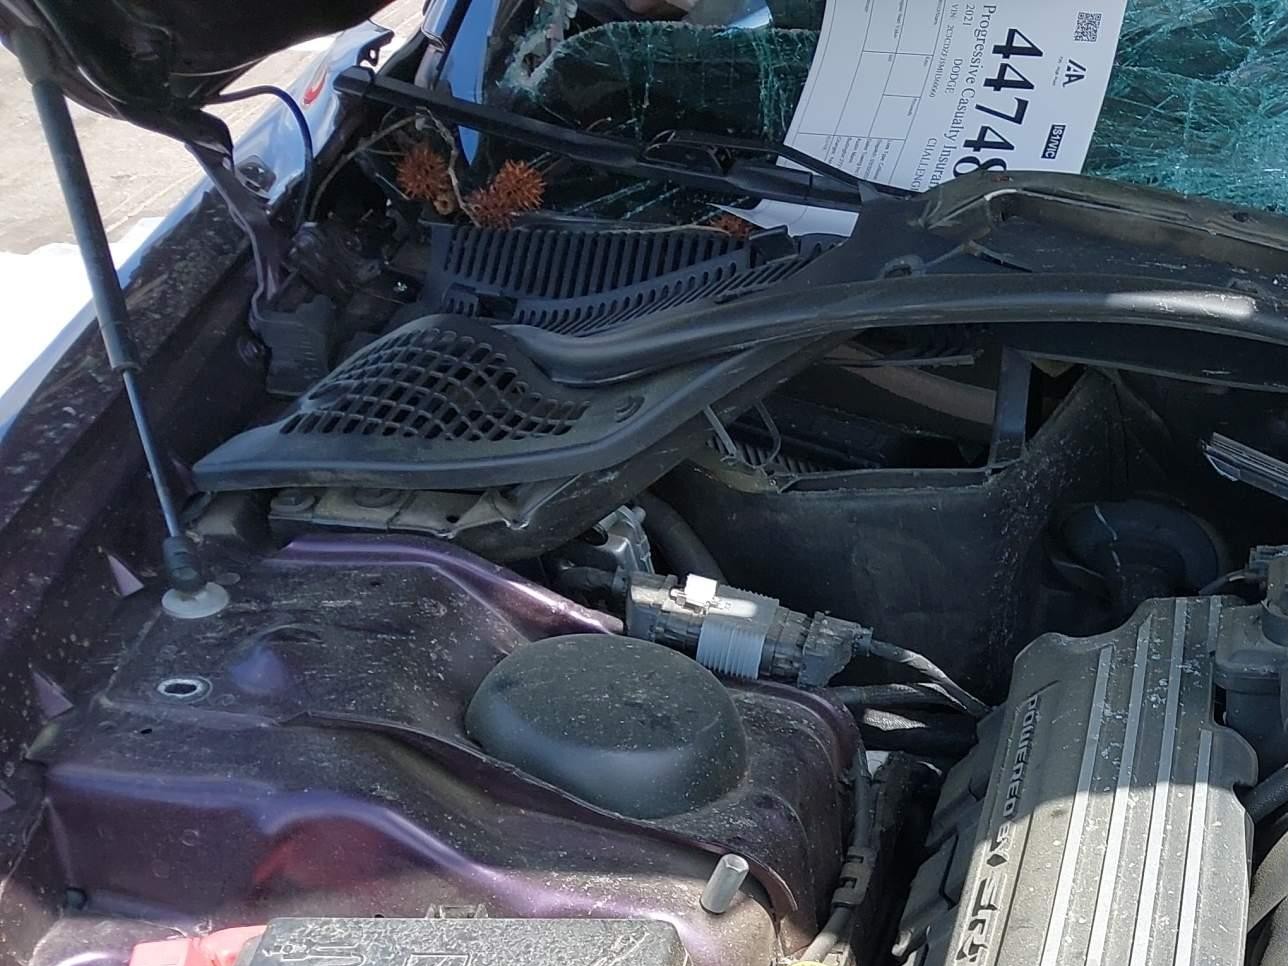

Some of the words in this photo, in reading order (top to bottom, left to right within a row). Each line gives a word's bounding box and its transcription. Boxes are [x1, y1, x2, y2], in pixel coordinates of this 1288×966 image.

[962, 4, 976, 26] 2021
[966, 5, 997, 85] Progressive
[944, 58, 963, 95] DODGE
[944, 88, 976, 142] Casualty
[1003, 694, 1038, 818] POWERED
